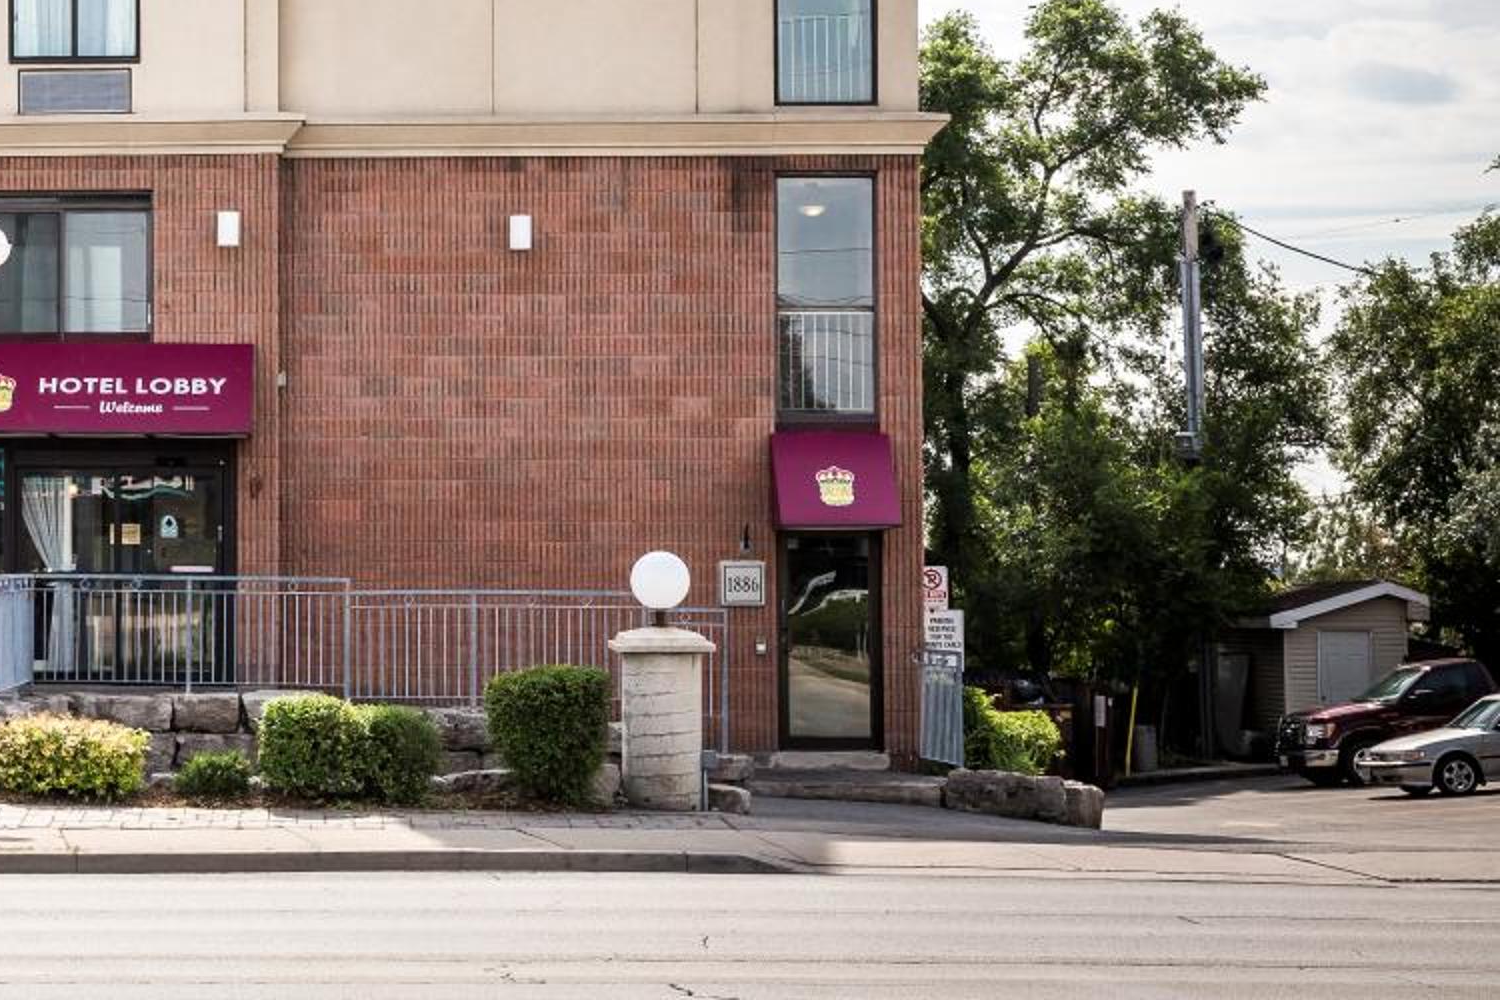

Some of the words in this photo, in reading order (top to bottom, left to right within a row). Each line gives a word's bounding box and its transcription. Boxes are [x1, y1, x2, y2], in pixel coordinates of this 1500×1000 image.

[38, 377, 128, 395] HOTEL
[135, 377, 228, 396] LOBBY
[99, 400, 164, 414] Welcome
[727, 576, 760, 593] 1886
